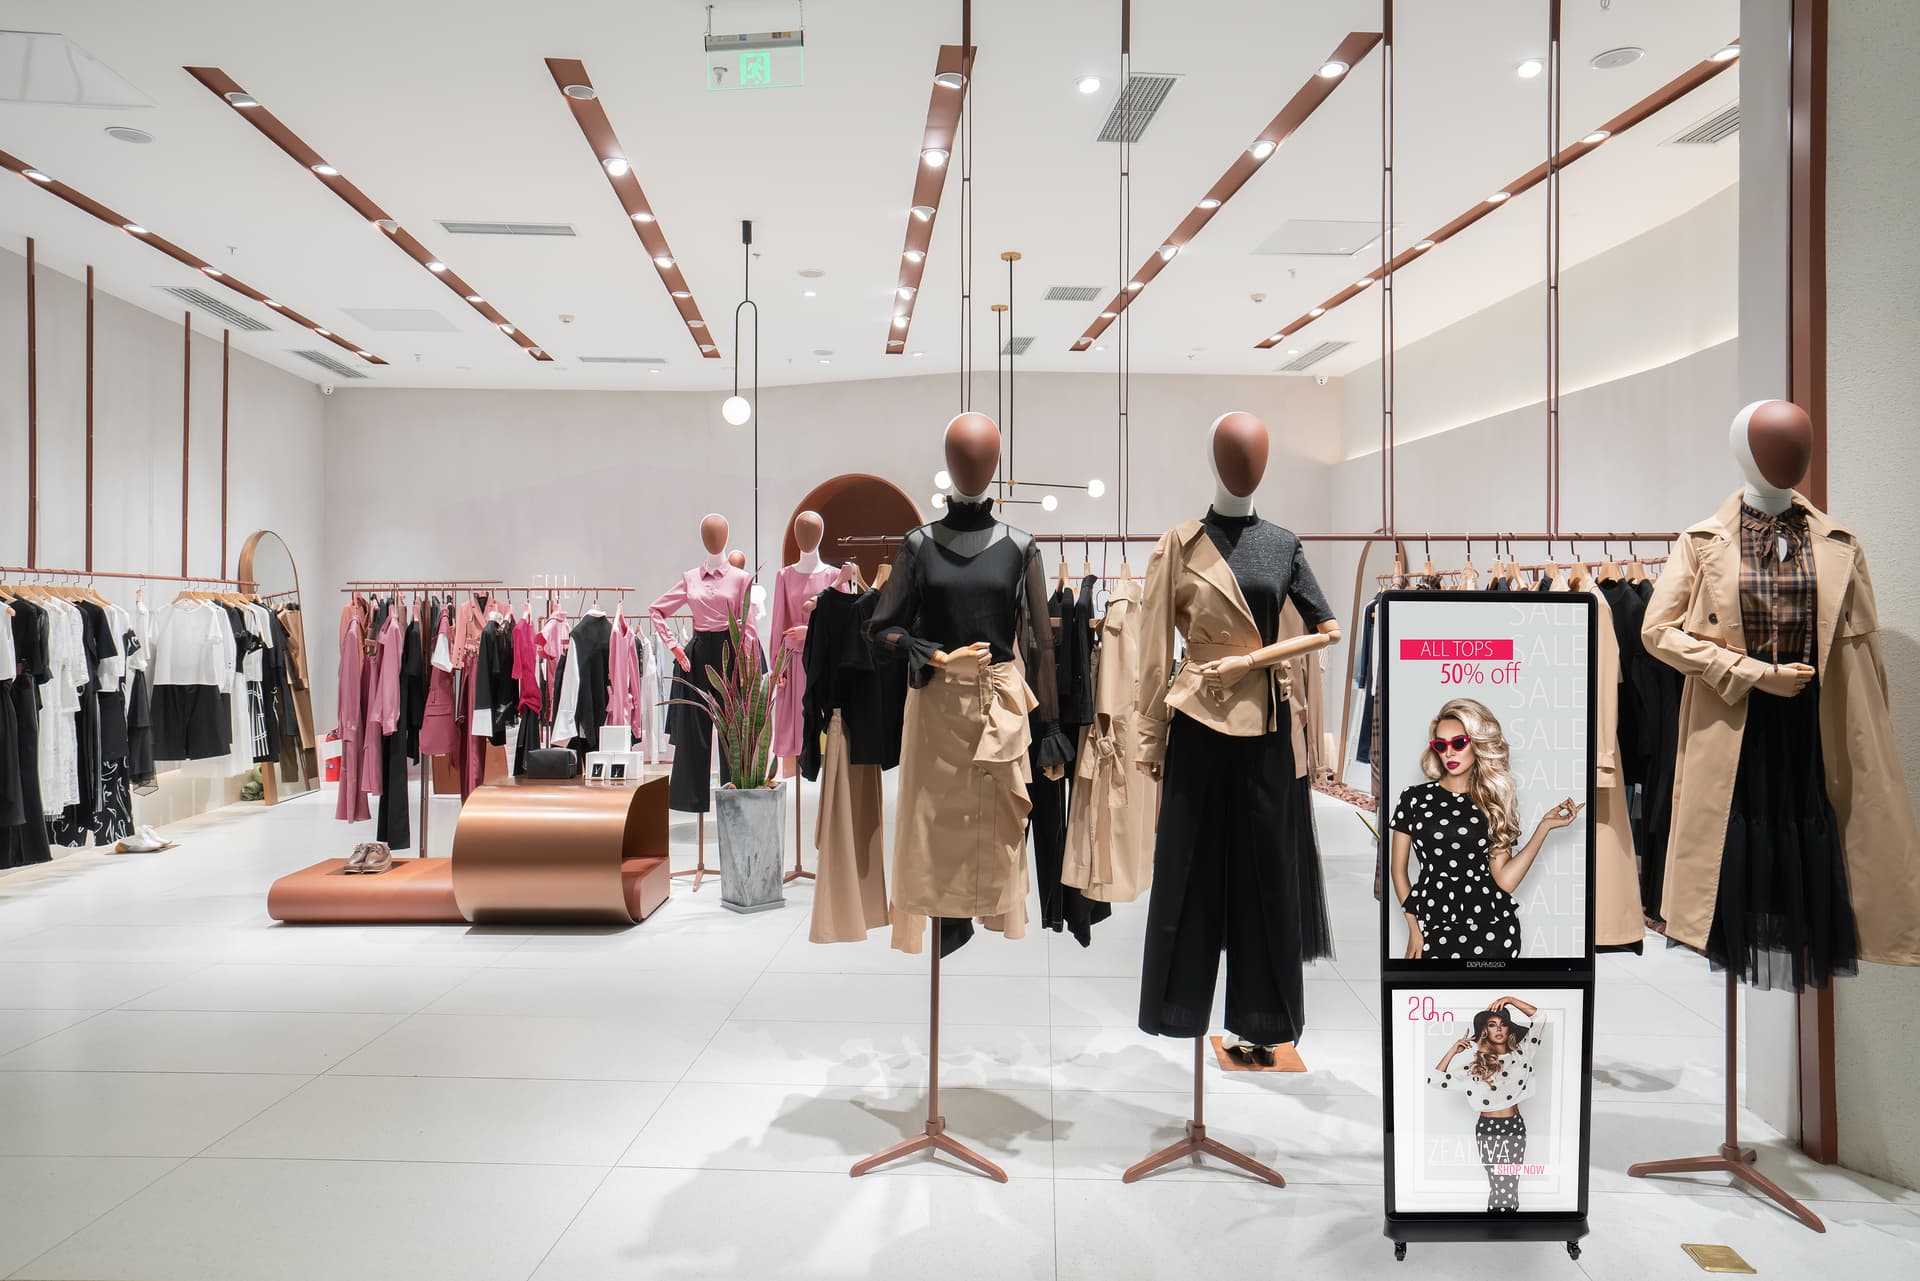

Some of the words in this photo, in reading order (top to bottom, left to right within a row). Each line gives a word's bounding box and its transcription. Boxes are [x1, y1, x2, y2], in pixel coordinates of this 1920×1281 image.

[1420, 640, 1449, 657] ALL
[1452, 640, 1493, 657] TOPS
[1440, 662, 1485, 685] 50%
[1491, 661, 1522, 685] off
[1508, 718, 1585, 751] SALE
[1408, 996, 1435, 1021] 20
[1497, 1164, 1521, 1175] SHOP
[1523, 1164, 1545, 1175] NOW
